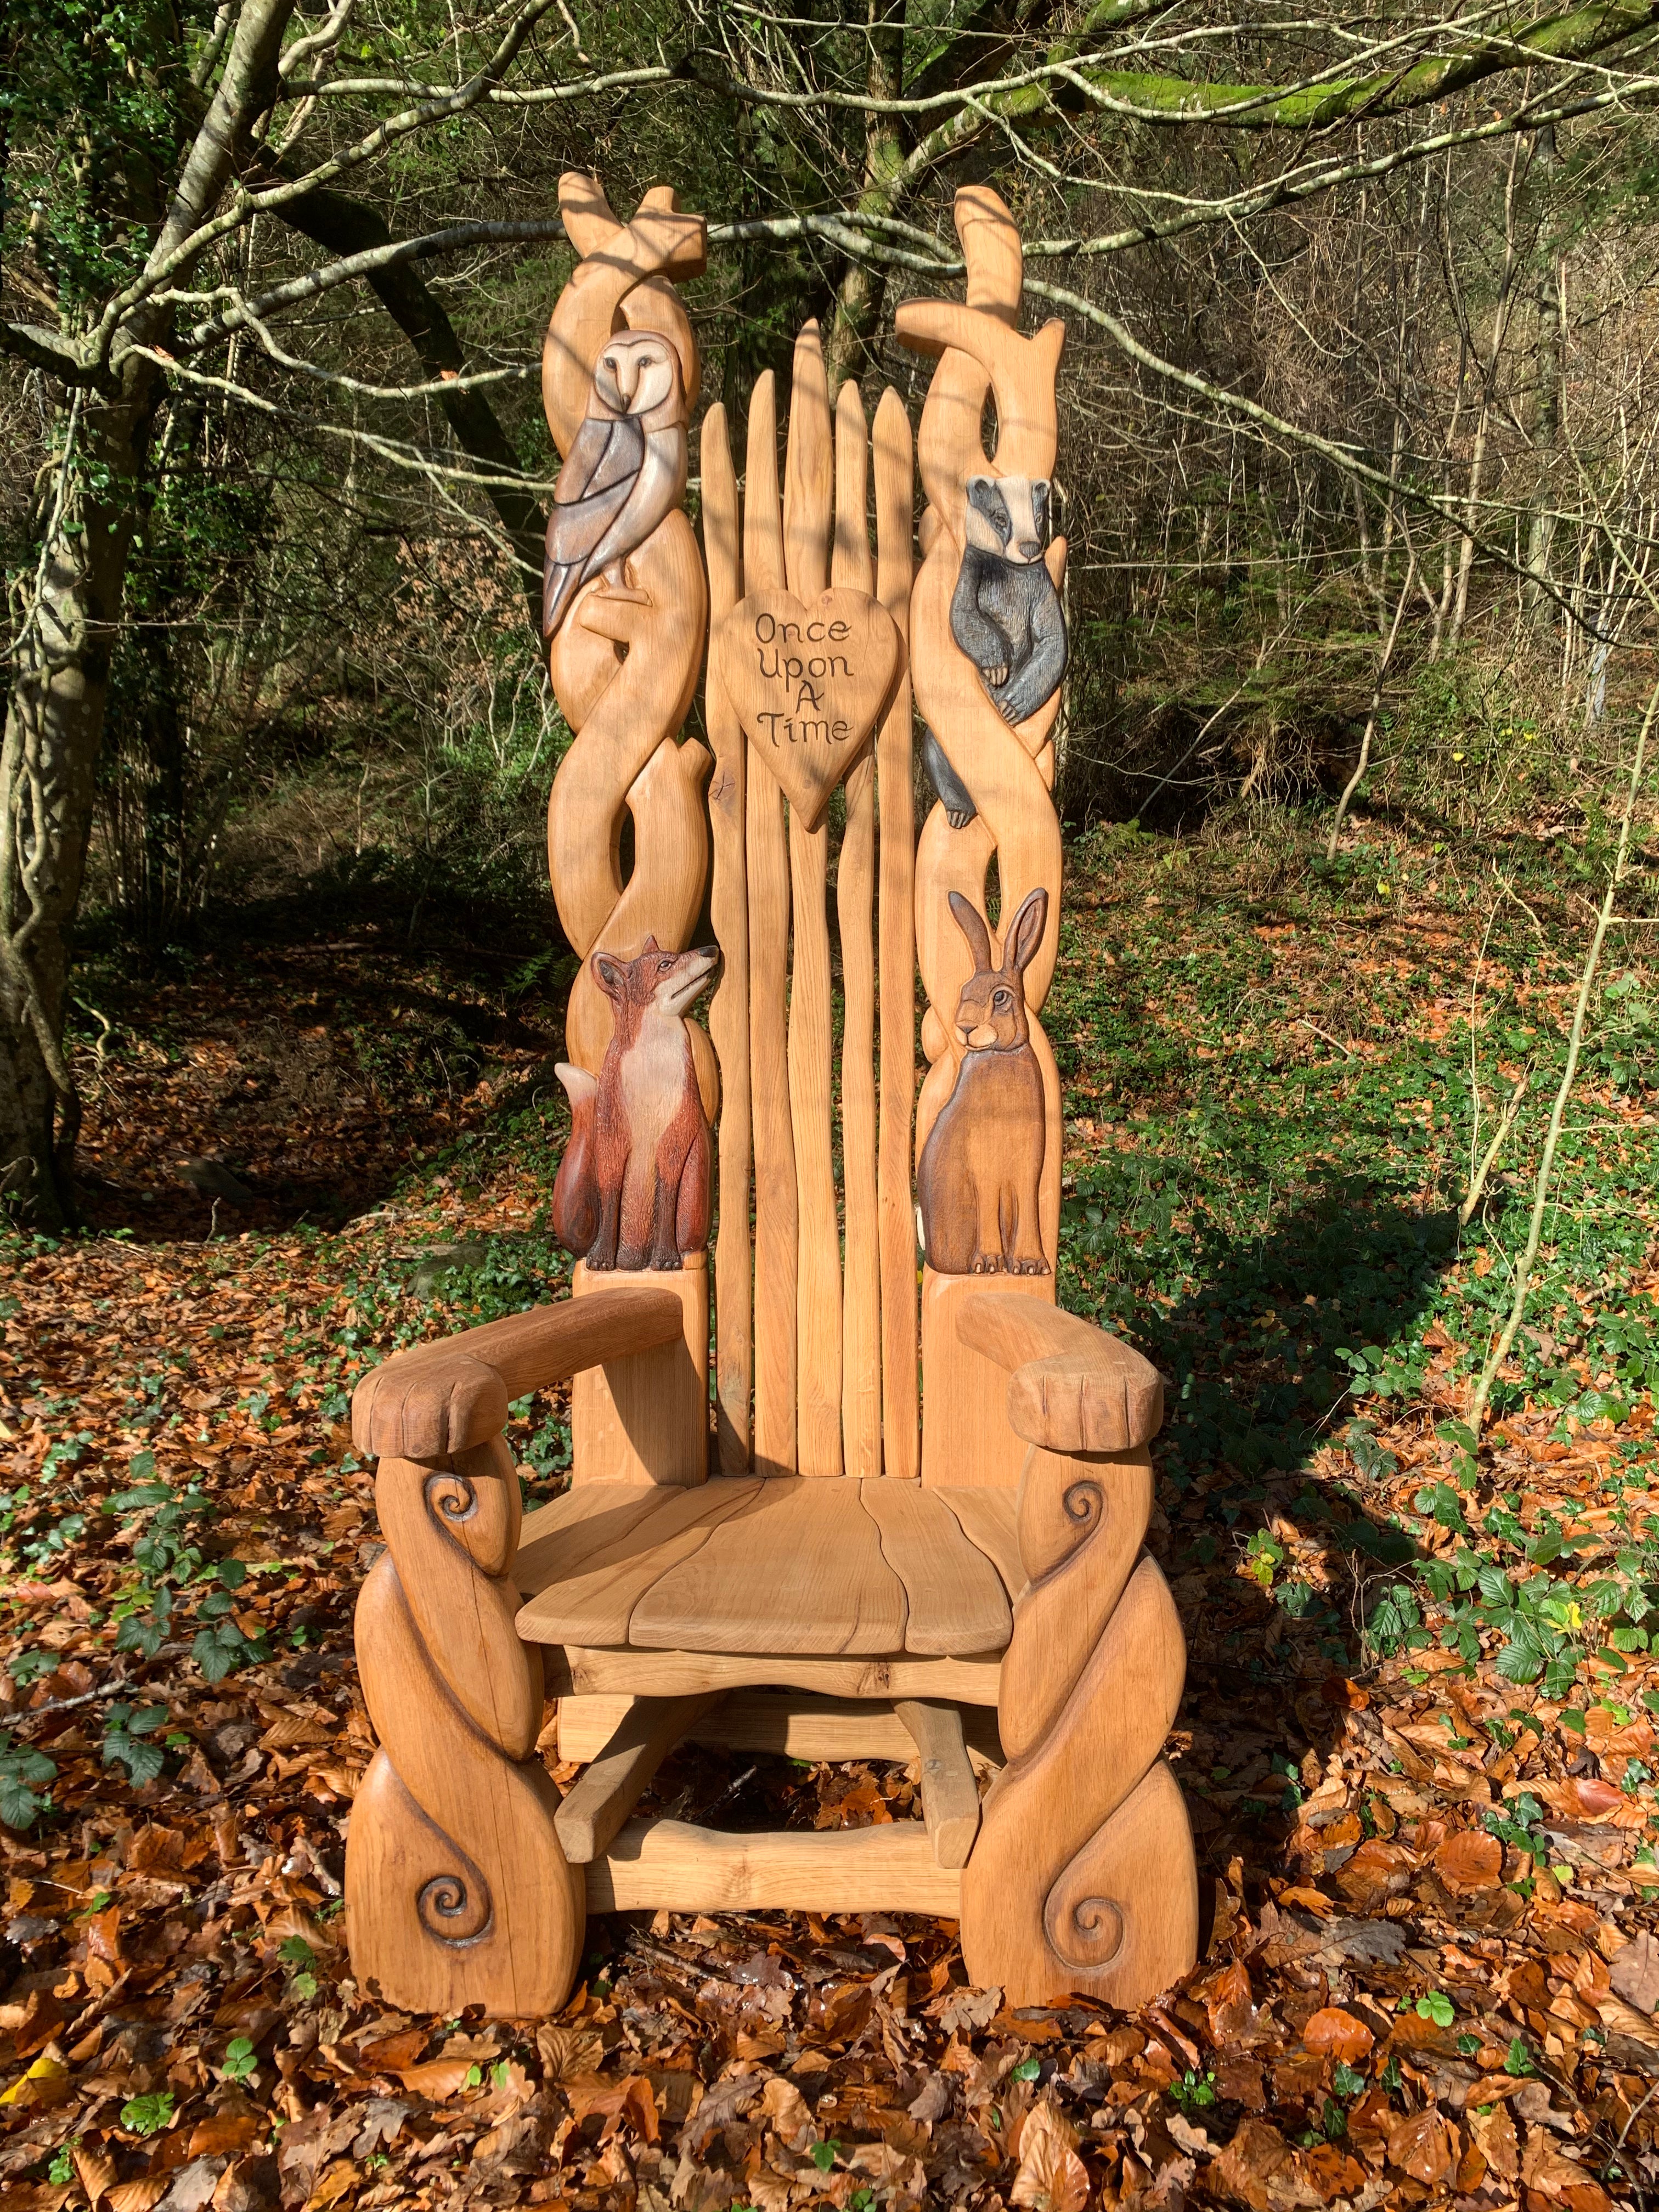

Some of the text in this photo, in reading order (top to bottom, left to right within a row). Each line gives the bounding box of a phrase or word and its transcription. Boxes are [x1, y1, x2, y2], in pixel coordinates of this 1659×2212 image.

[755, 613, 851, 644] Once
[757, 648, 854, 693] Upon
[795, 680, 825, 714] A
[757, 712, 854, 747] Time
